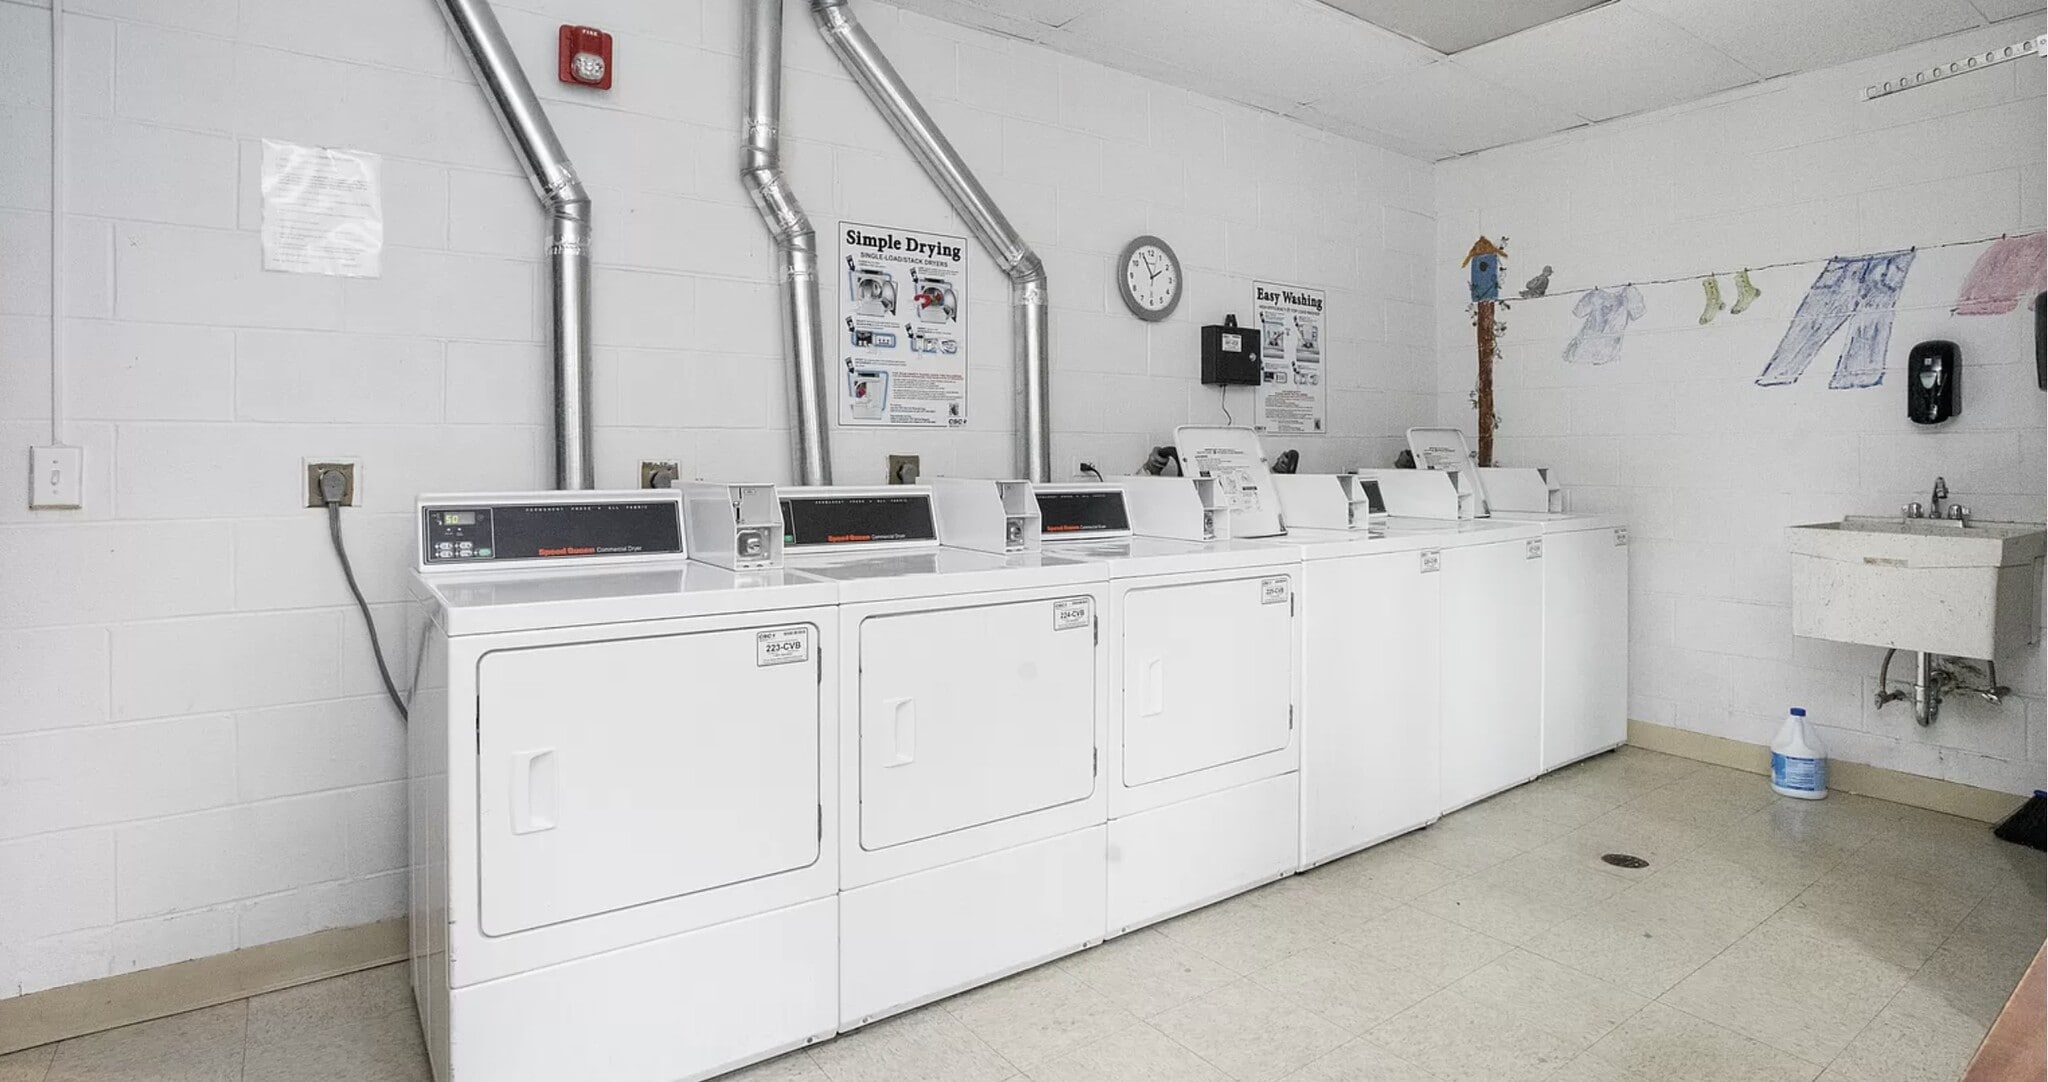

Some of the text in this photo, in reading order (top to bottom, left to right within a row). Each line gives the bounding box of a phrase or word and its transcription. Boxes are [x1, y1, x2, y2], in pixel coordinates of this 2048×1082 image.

[582, 29, 598, 37] FIRE
[846, 229, 962, 262] Simple Drying
[1147, 249, 1155, 257] 12
[924, 259, 949, 268] DRYERS
[1159, 296, 1164, 304] 5
[1256, 287, 1323, 312] Easy Washing
[445, 515, 459, 524] 50
[827, 534, 849, 543] Speed
[538, 547, 567, 557] Speed
[567, 547, 596, 556] Queen
[1060, 609, 1085, 619] 224-CVB
[766, 641, 801, 653] 223-CVB
